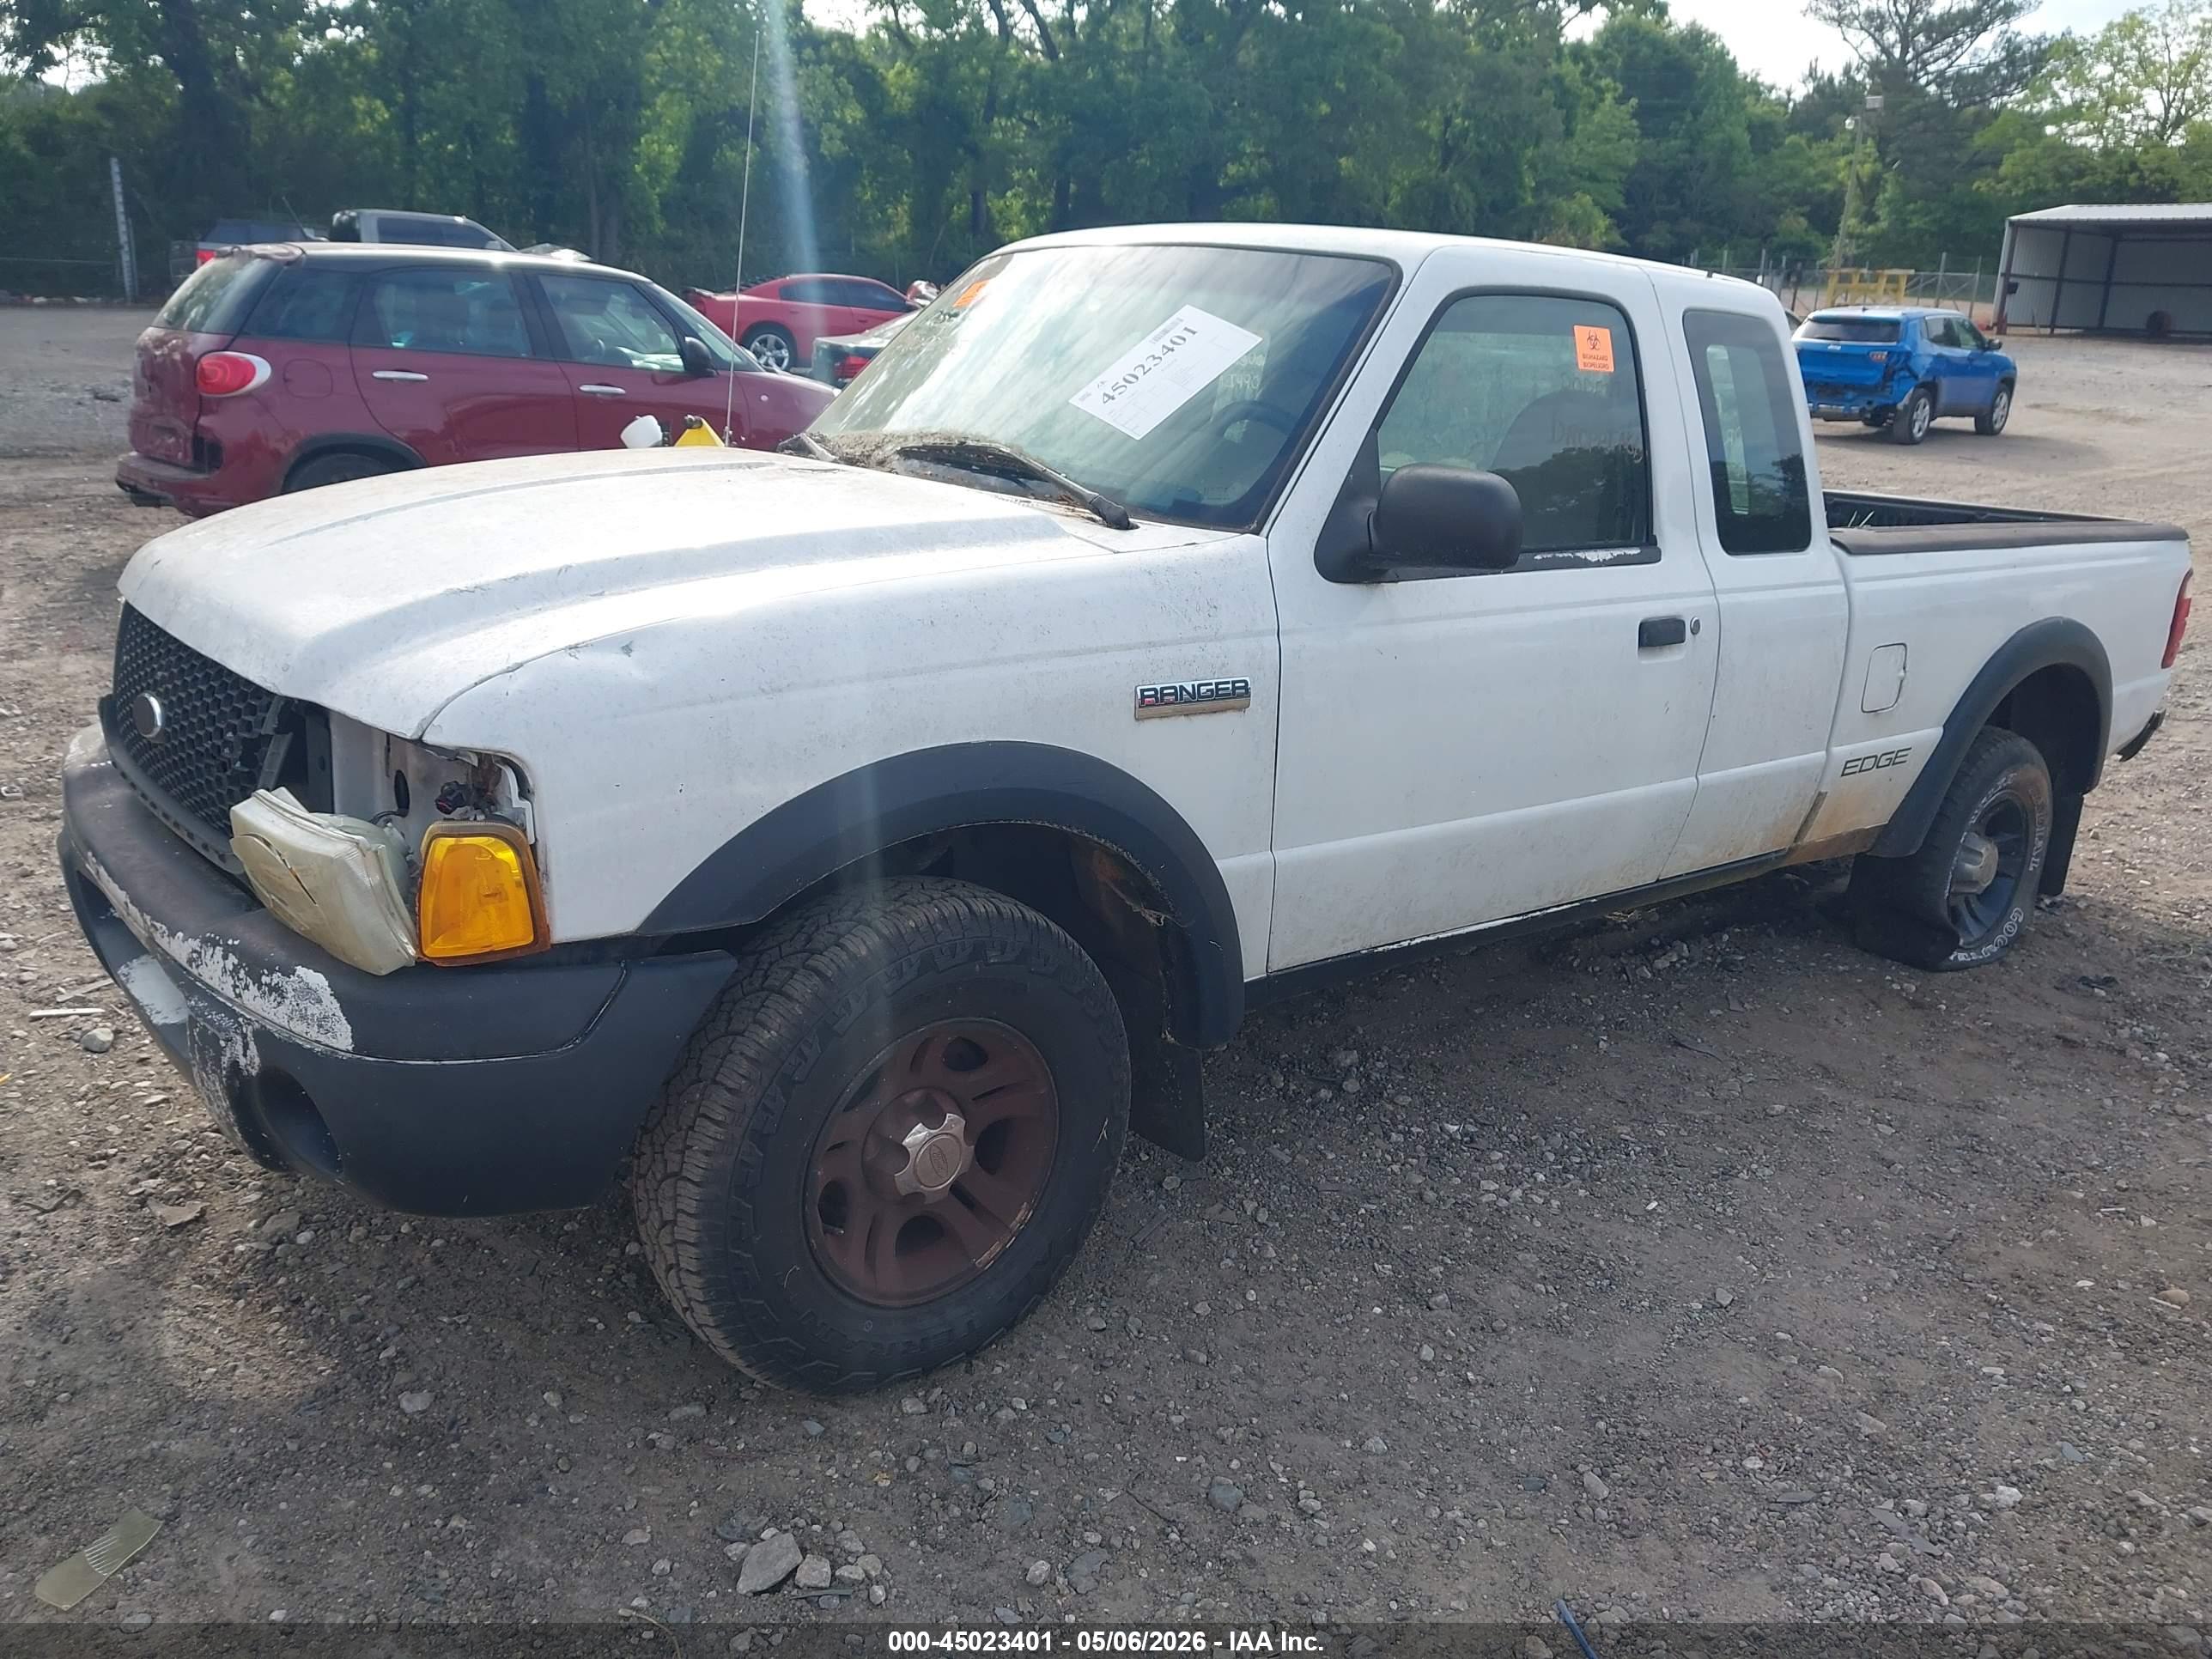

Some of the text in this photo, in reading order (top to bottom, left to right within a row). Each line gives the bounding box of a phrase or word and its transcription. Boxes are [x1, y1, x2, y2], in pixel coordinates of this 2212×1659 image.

[1102, 326, 1198, 404] 45023401
[1139, 678, 1249, 706] RANGER
[1840, 747, 1912, 777] EDGE
